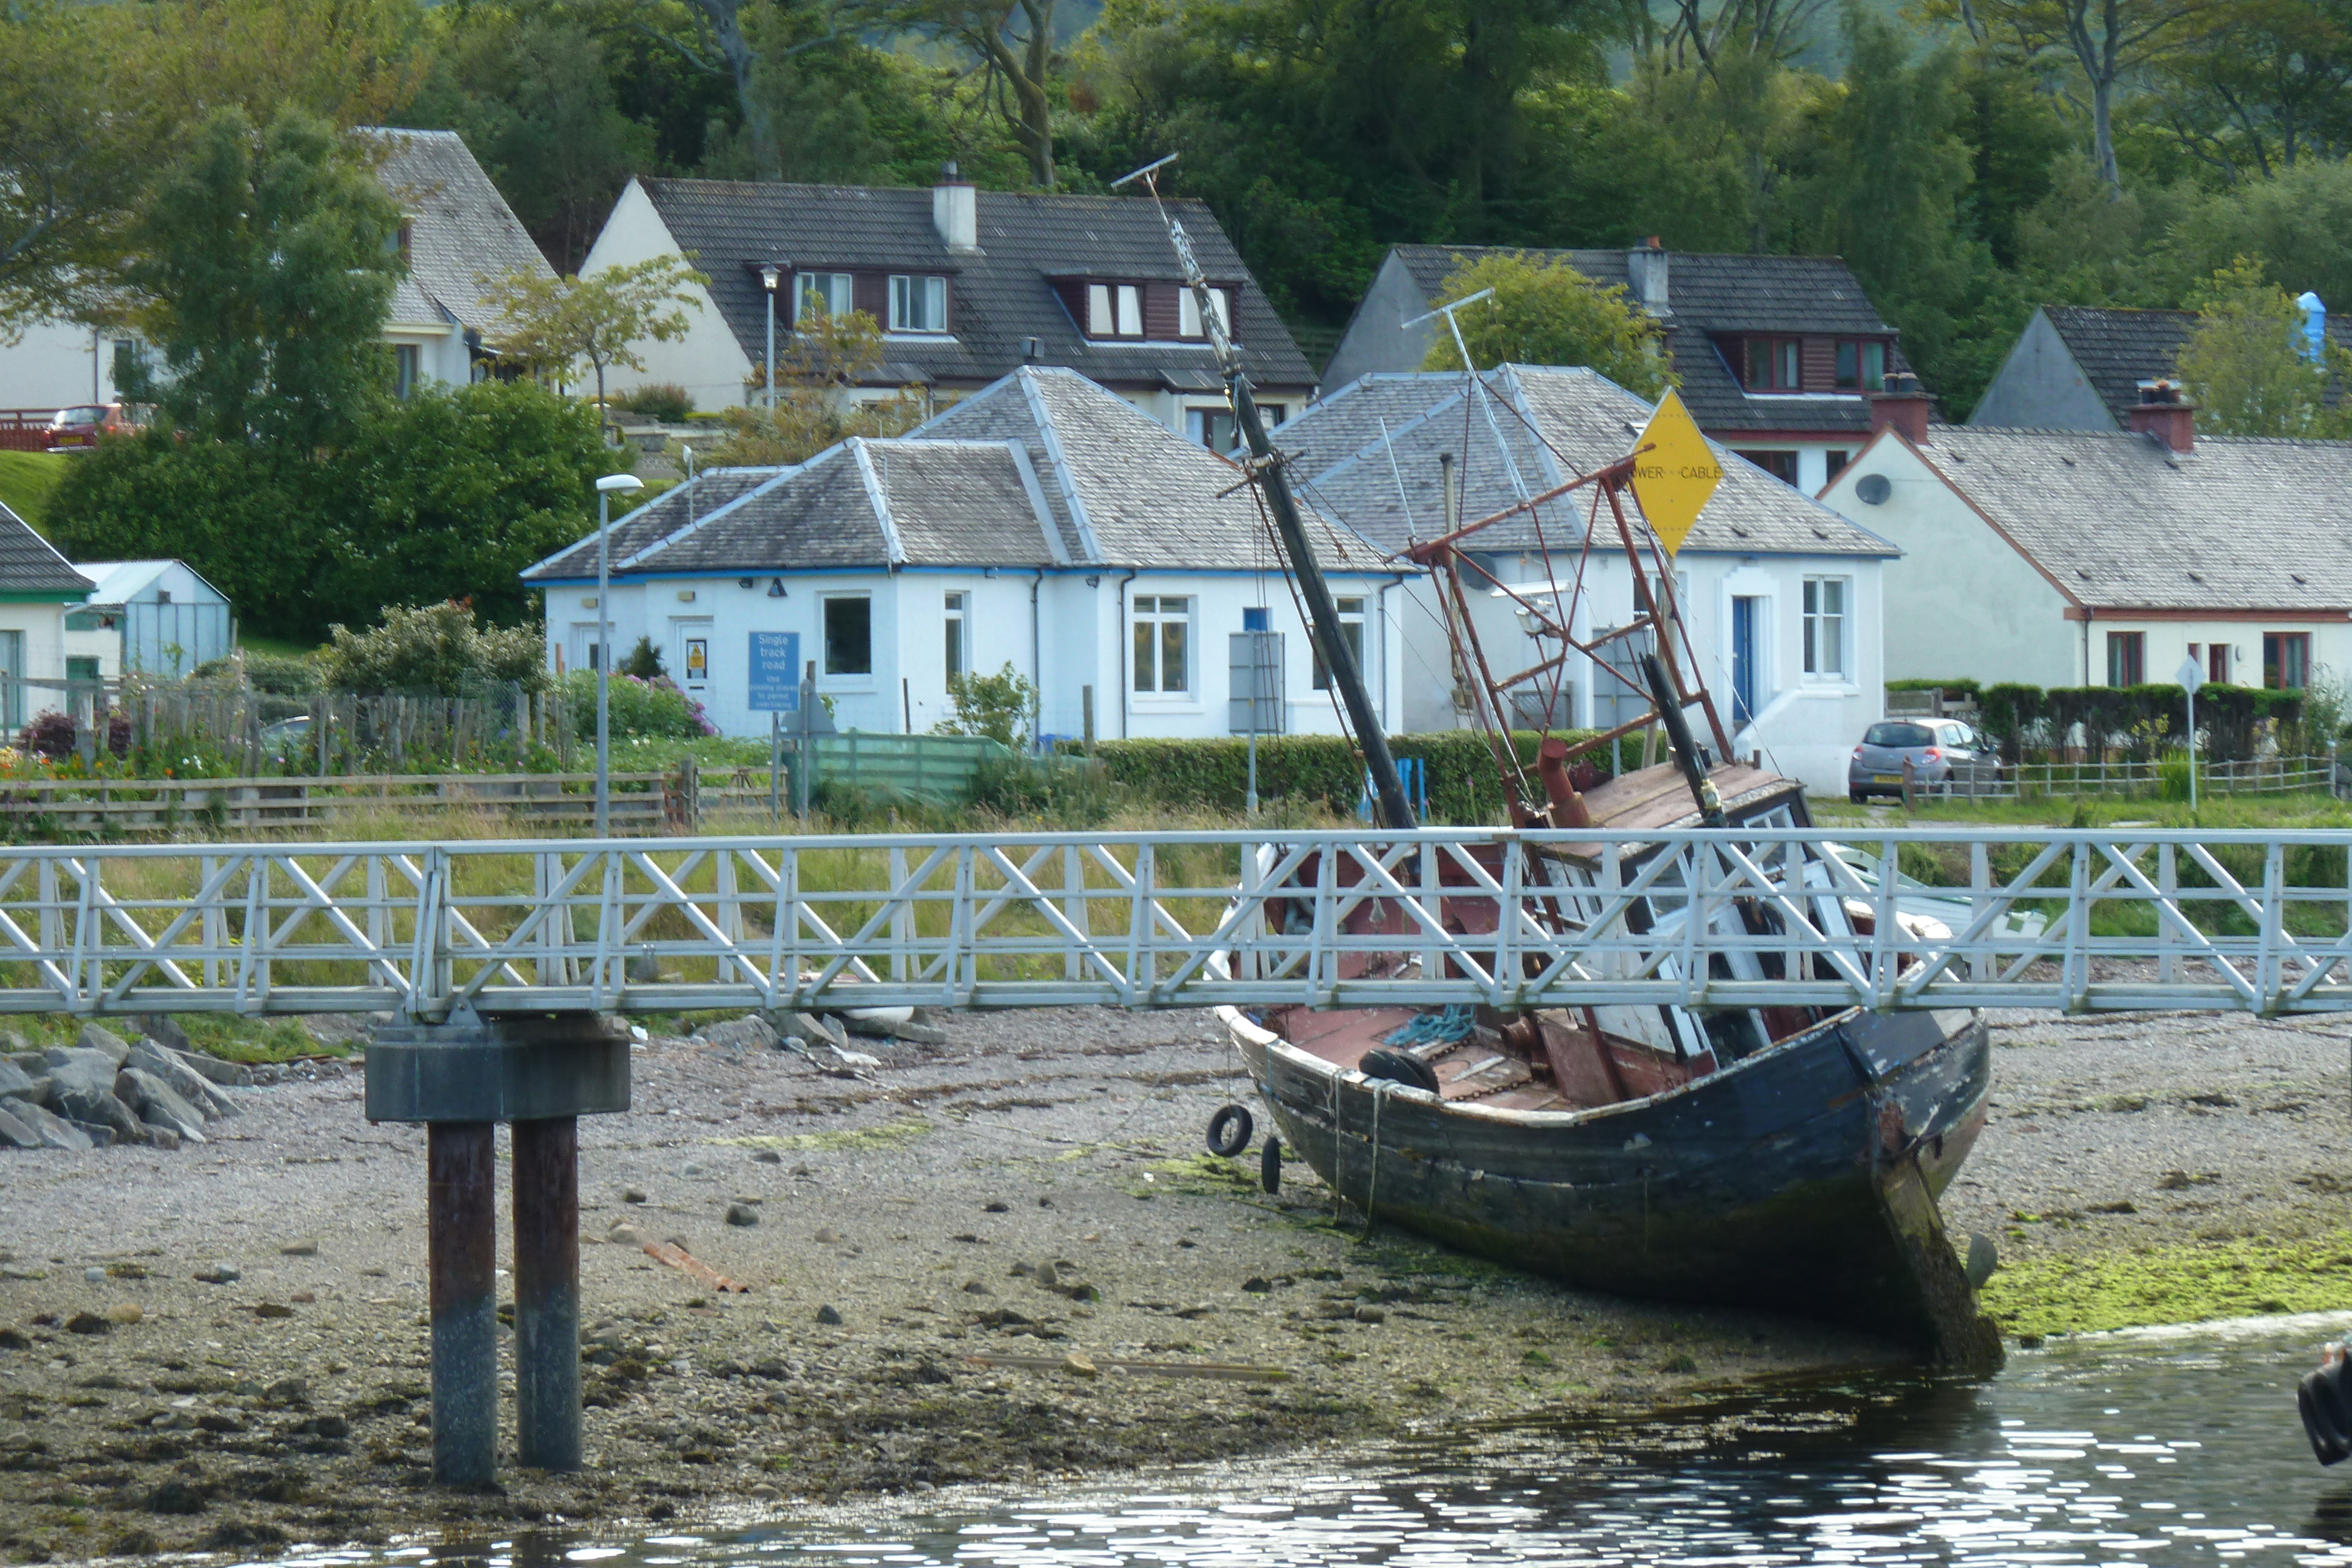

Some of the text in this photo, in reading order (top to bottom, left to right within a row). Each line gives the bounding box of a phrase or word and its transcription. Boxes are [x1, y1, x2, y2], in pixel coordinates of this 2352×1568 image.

[1633, 466, 1721, 479] WER CABLE
[759, 634, 789, 646] Single
[760, 647, 786, 657] track
[763, 660, 785, 670] road
[767, 693, 789, 701] permit
